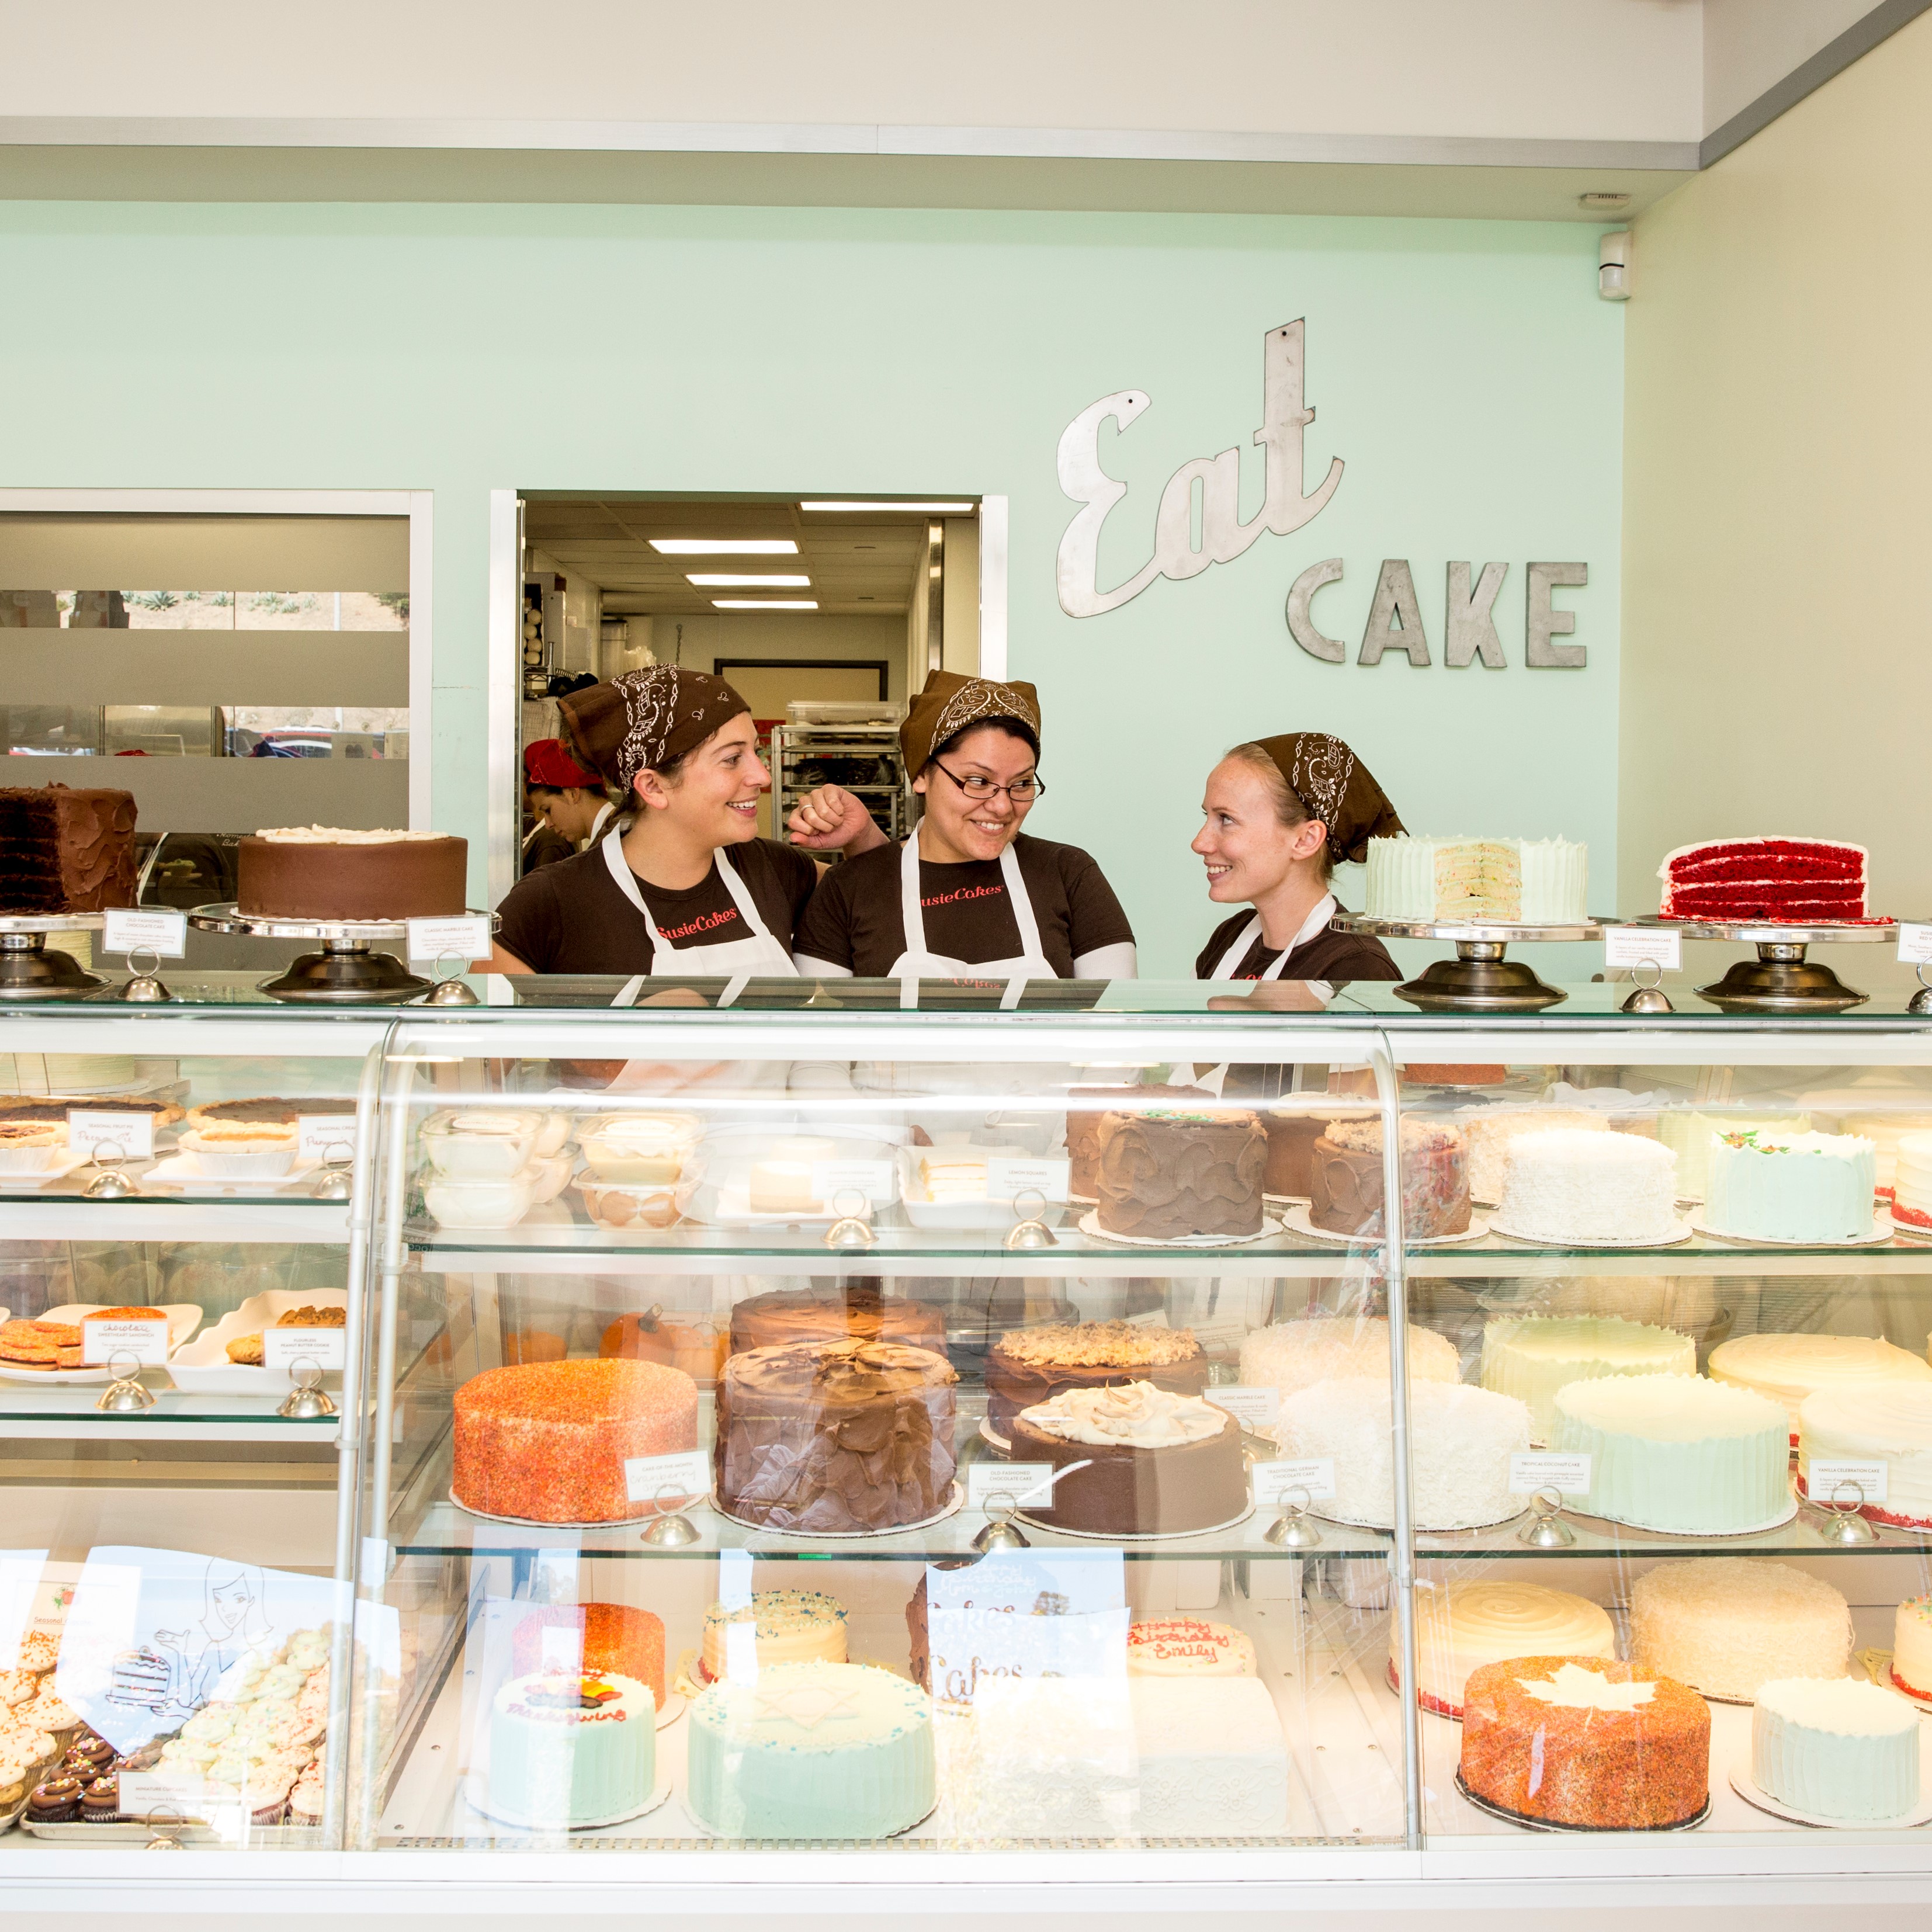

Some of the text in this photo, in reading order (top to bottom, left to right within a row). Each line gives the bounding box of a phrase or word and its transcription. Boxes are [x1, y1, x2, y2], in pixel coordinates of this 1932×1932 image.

[1056, 316, 1344, 618] Eat
[1286, 558, 1588, 668] CAKE
[921, 886, 1001, 906] usieCakes
[657, 908, 737, 939] SusieCakes
[1154, 1643, 1219, 1663] Emily
